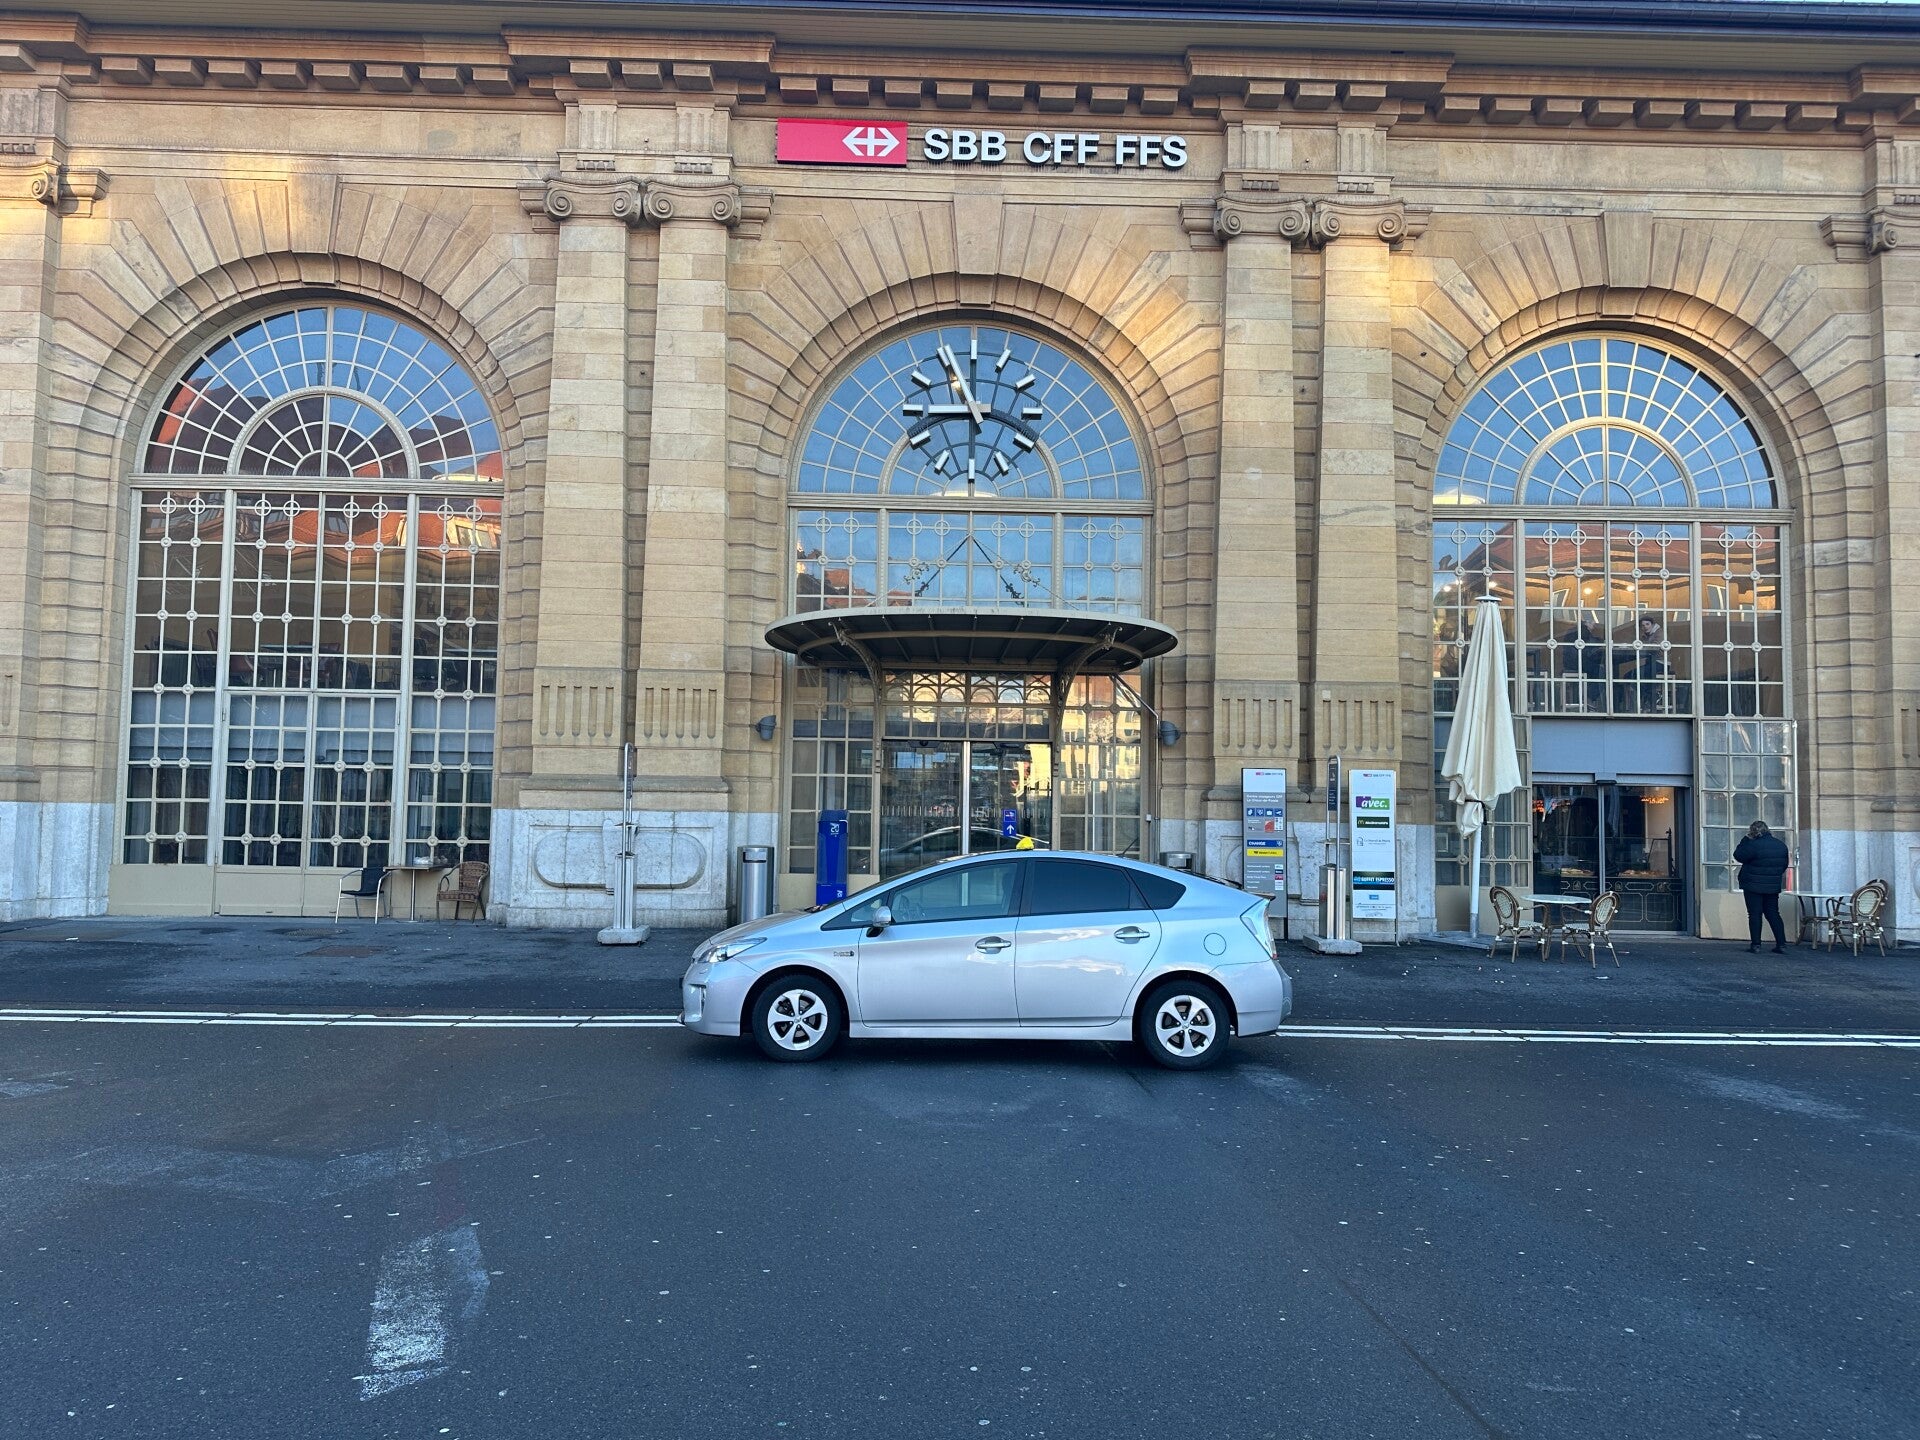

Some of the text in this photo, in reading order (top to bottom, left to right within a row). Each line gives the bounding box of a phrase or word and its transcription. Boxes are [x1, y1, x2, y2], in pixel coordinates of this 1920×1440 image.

[924, 128, 1188, 168] SBB CFF FFS
[1361, 799, 1388, 808] avec.
